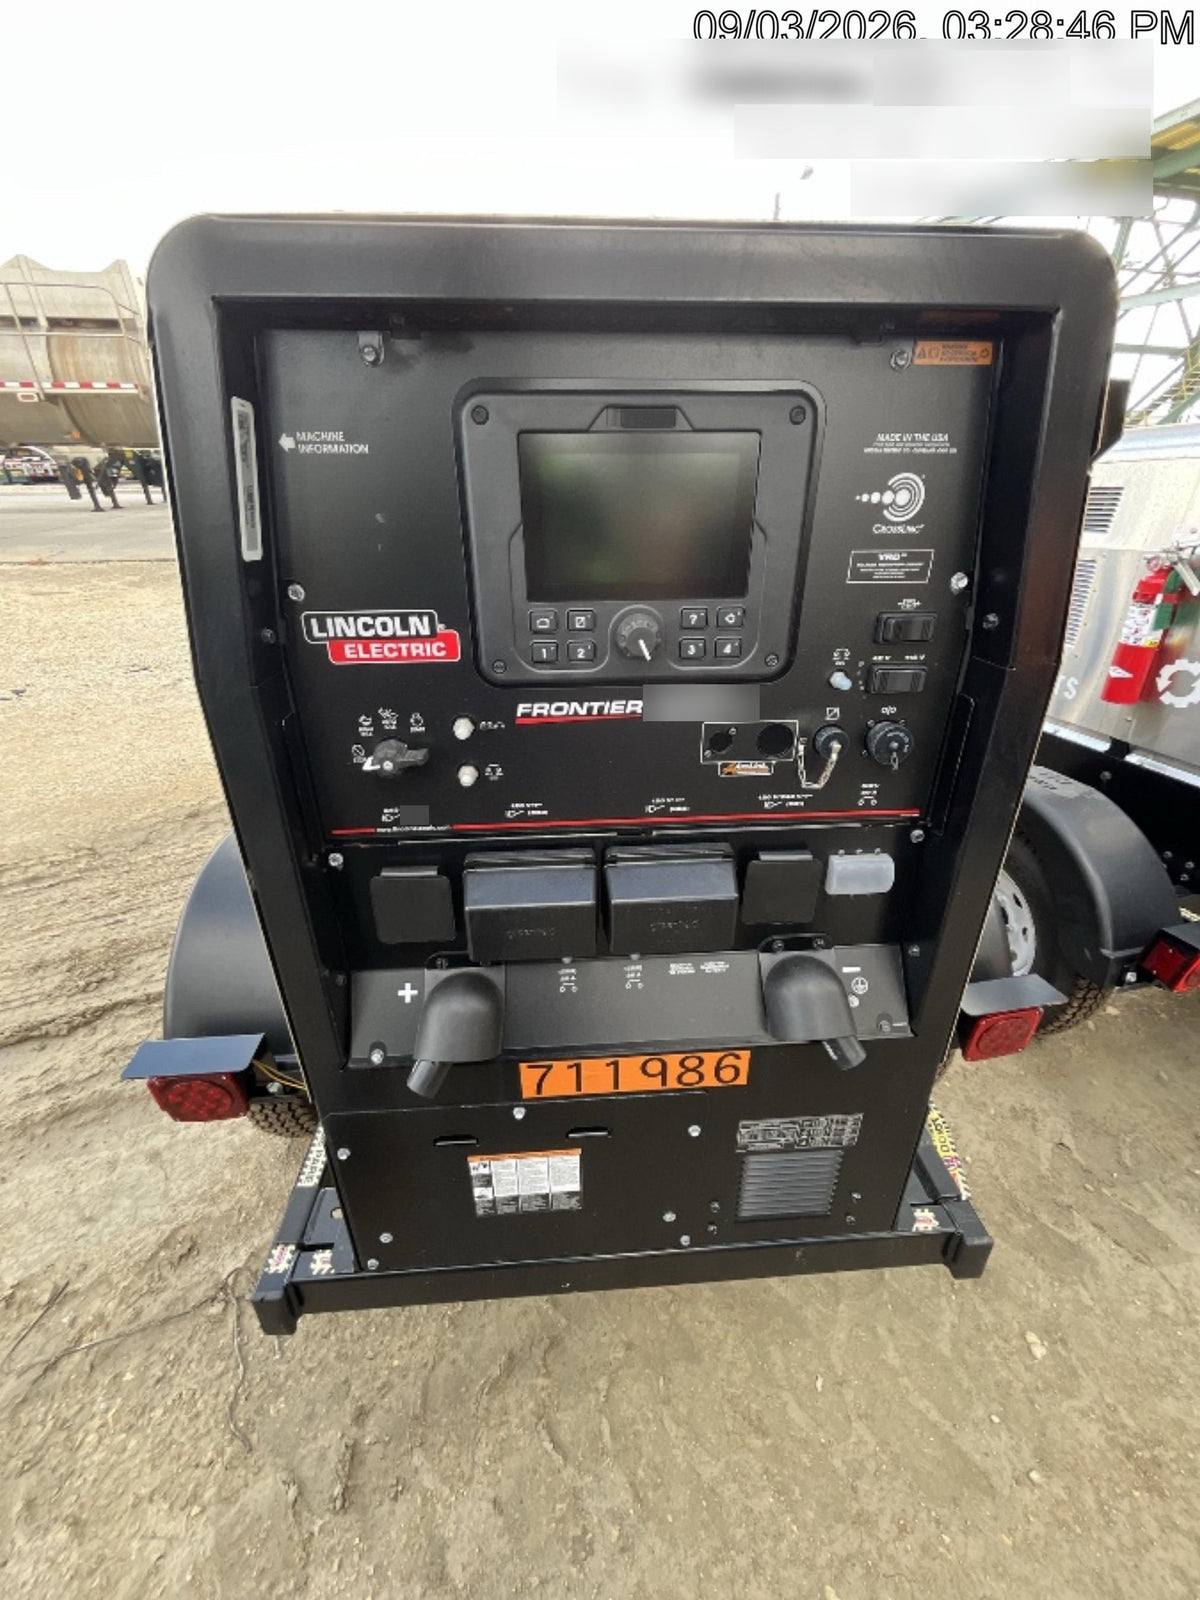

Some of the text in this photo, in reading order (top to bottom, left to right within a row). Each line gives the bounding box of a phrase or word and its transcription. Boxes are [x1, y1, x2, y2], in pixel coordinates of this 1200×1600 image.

[296, 431, 345, 442] MACHINE
[876, 433, 901, 442] MADE
[298, 443, 369, 454] INFORMATION
[310, 615, 431, 638] LINCOLN
[344, 640, 447, 659] ELECTRIC
[577, 648, 586, 659] 2
[516, 700, 643, 717] FRONTIER
[527, 1053, 744, 1095] 711986
